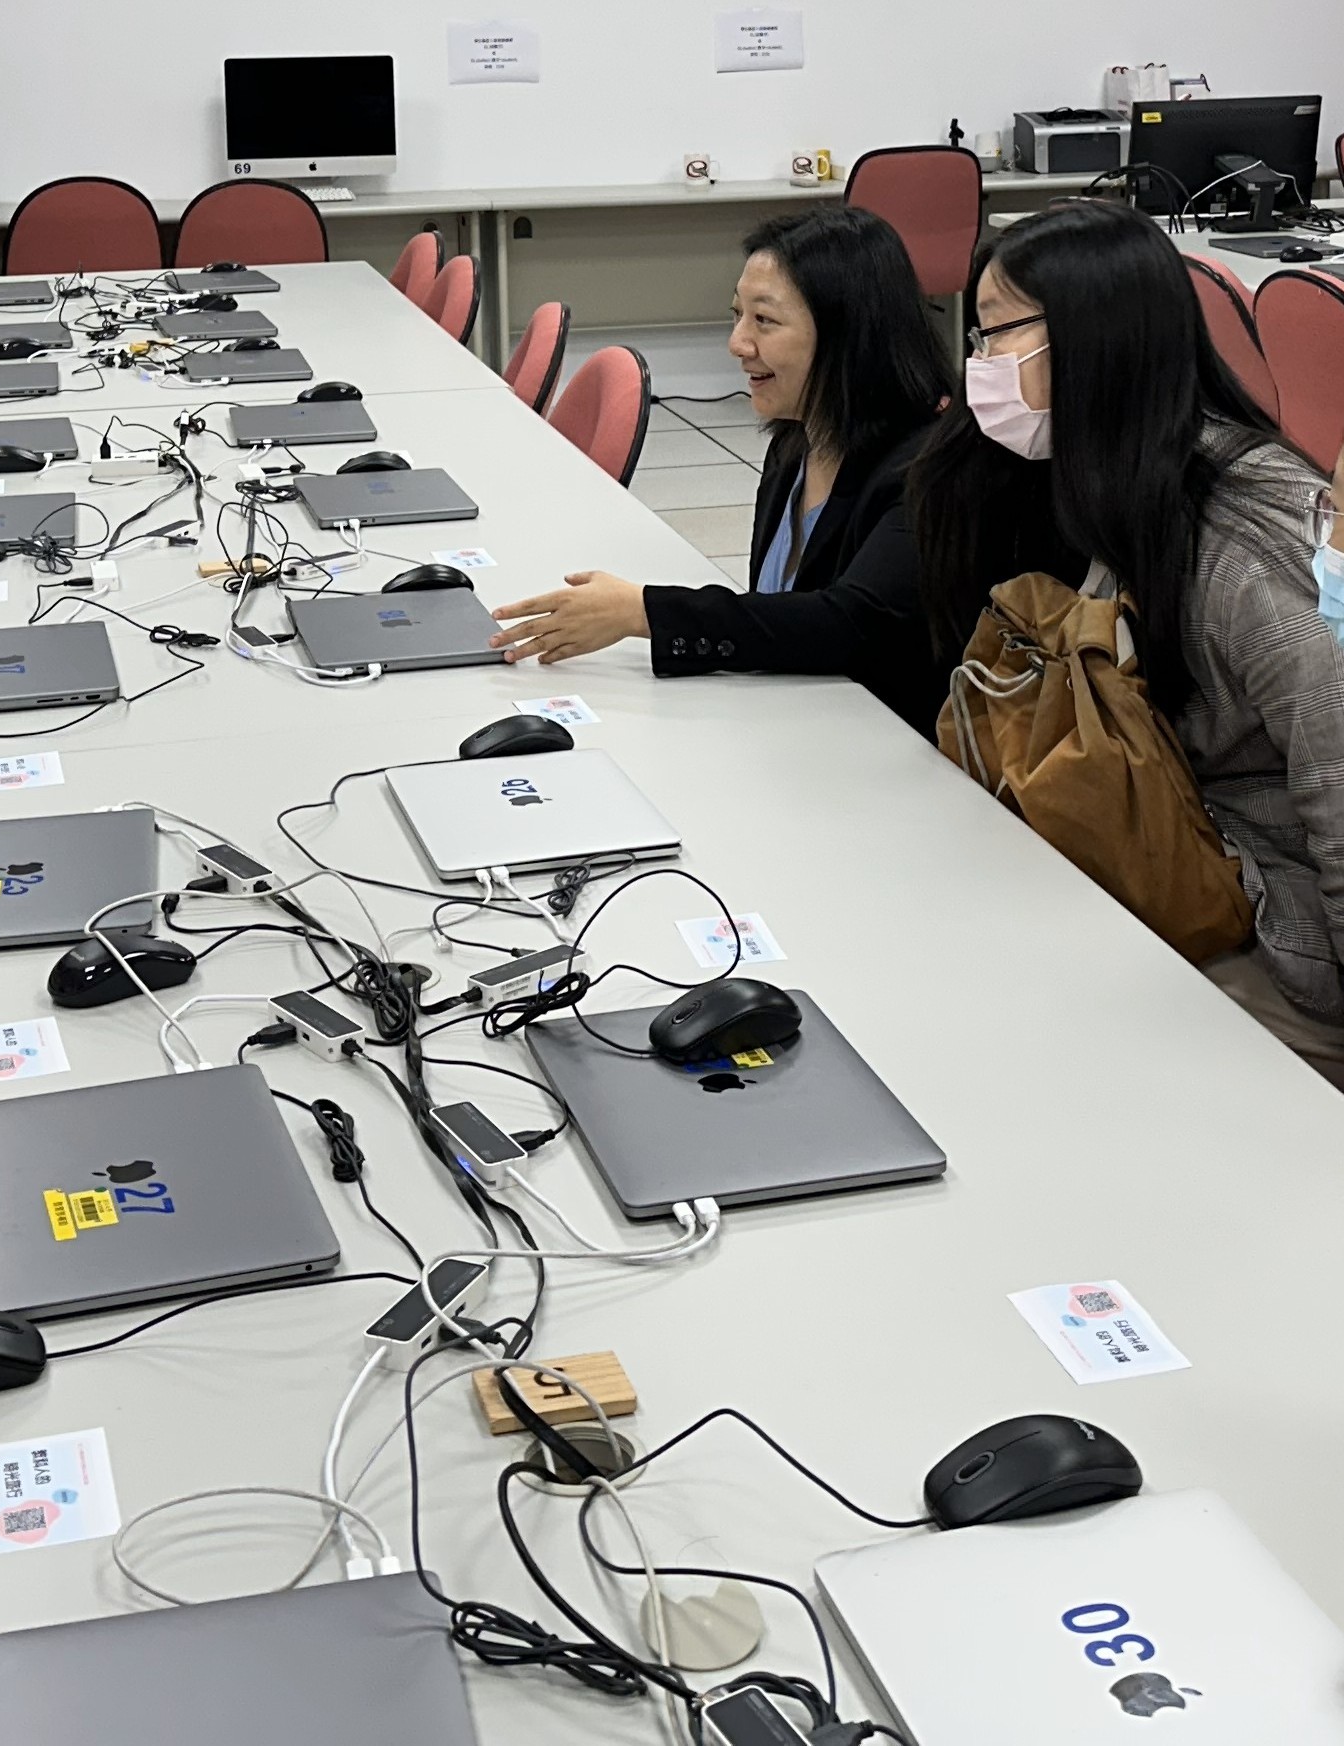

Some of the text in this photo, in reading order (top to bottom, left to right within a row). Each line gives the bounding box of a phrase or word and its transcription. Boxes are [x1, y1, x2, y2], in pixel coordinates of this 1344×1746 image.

[234, 162, 251, 175] 69
[500, 778, 537, 796] 26
[114, 1182, 175, 1213] 27
[534, 1367, 572, 1399] 5
[1061, 1603, 1155, 1666] 30
